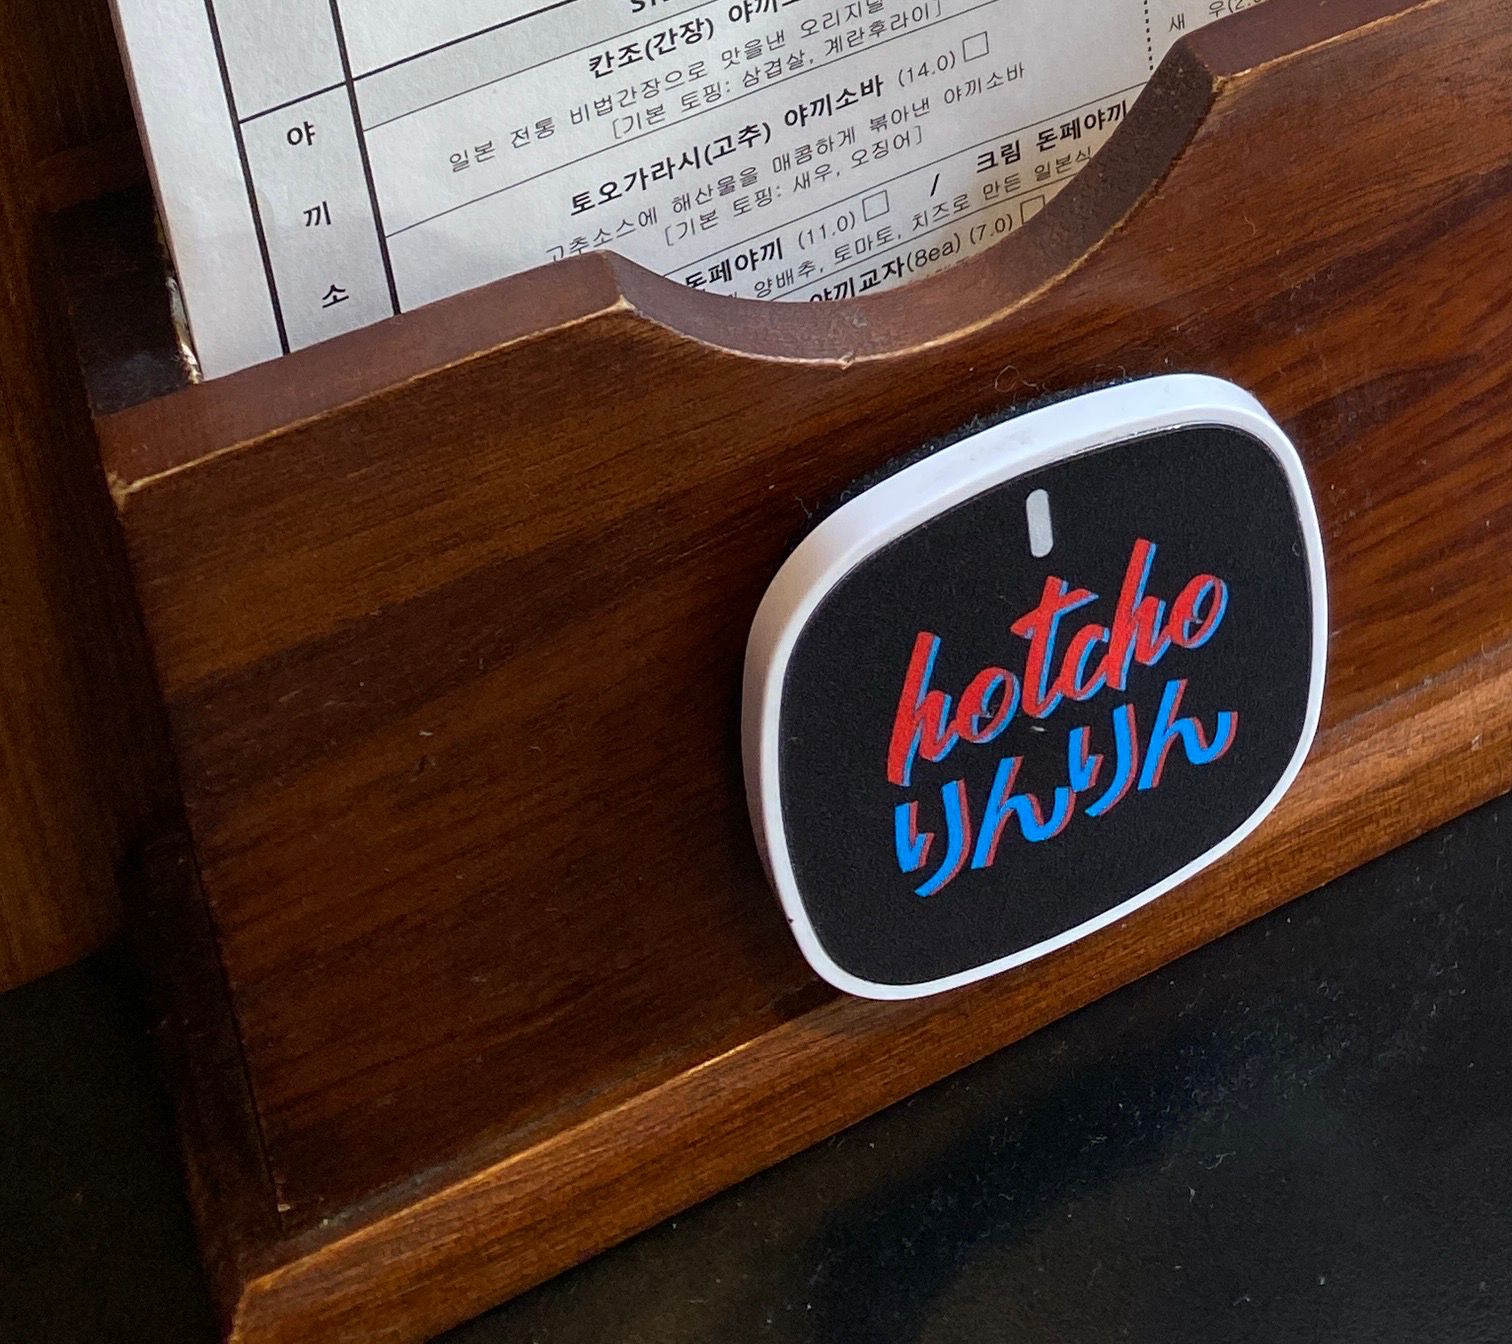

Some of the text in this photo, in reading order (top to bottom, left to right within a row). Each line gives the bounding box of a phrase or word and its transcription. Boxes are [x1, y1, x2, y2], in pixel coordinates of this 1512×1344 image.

[589, 17, 713, 78] 칸조(간장)
[887, 538, 1229, 787] hotcho
[894, 679, 1239, 898] りんりん
